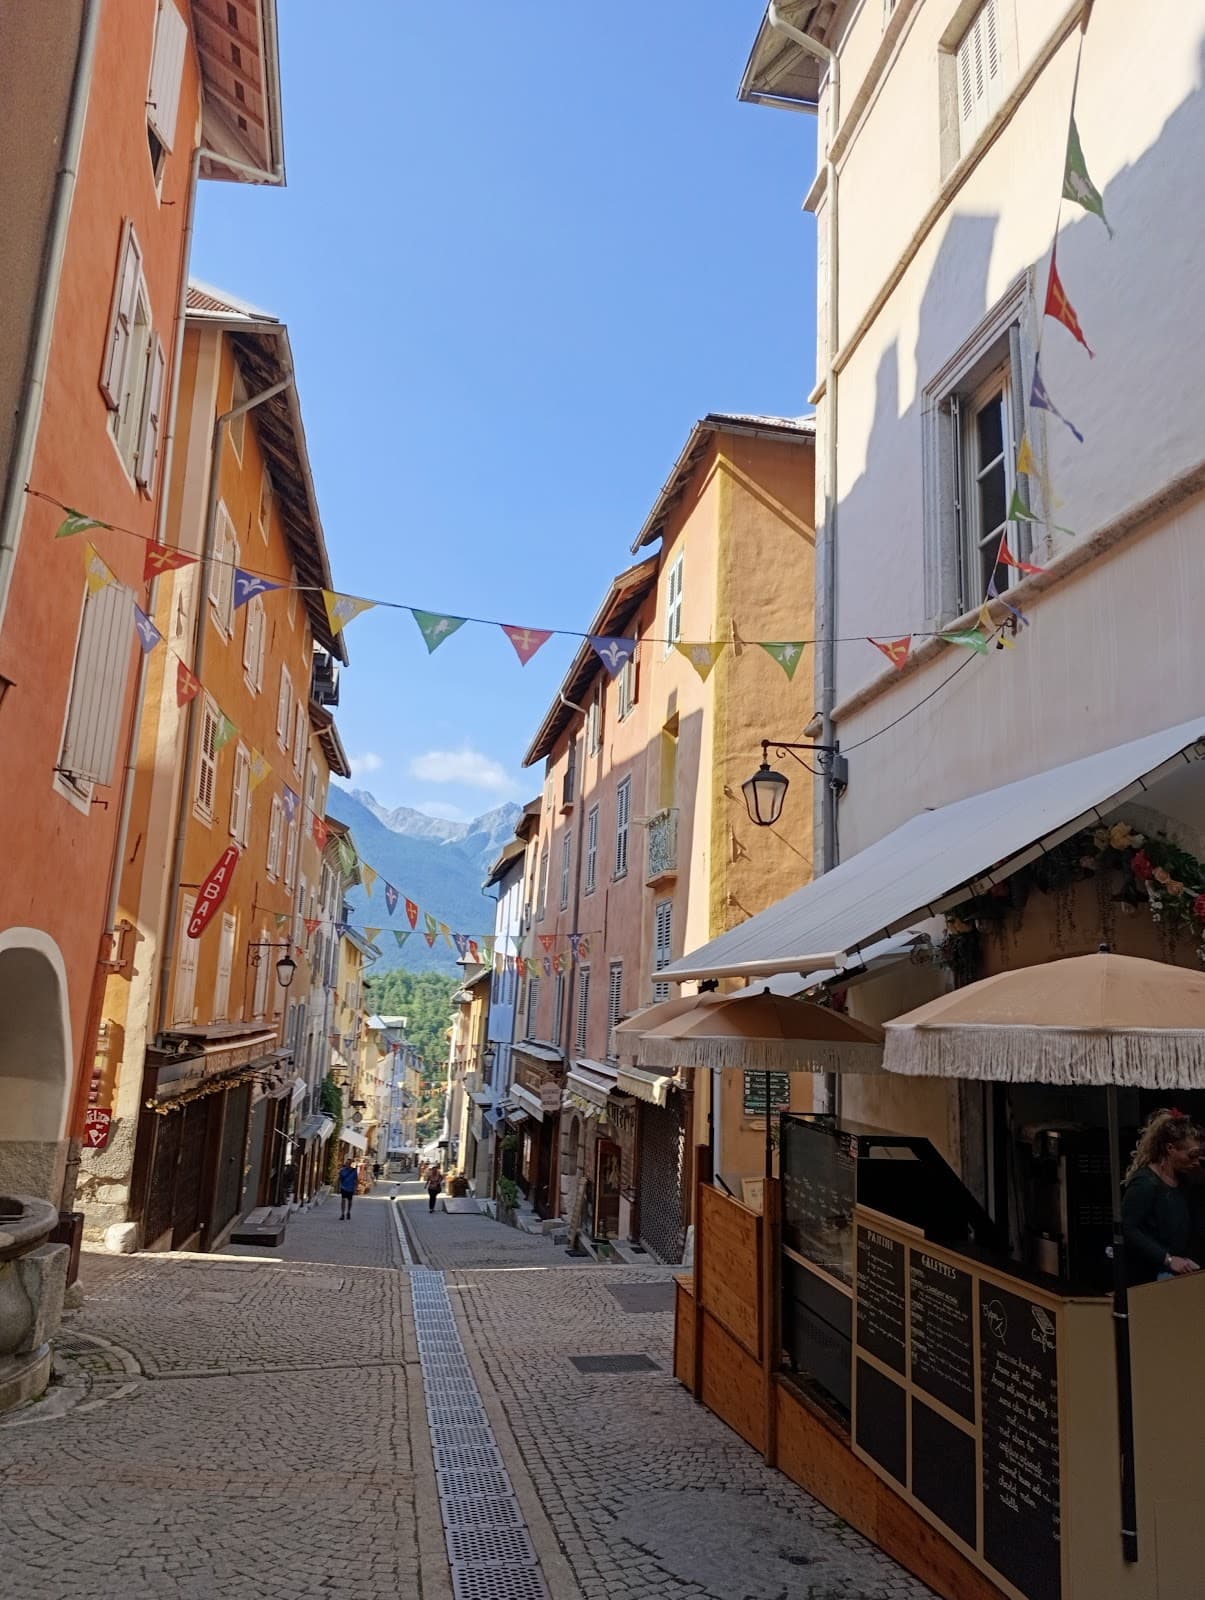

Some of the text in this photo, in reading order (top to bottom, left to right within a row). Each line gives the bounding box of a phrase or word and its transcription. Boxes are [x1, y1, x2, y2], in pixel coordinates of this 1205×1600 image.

[190, 850, 235, 933] TABAC
[867, 1230, 893, 1251] PANINI
[921, 1255, 956, 1279] GALETTES
